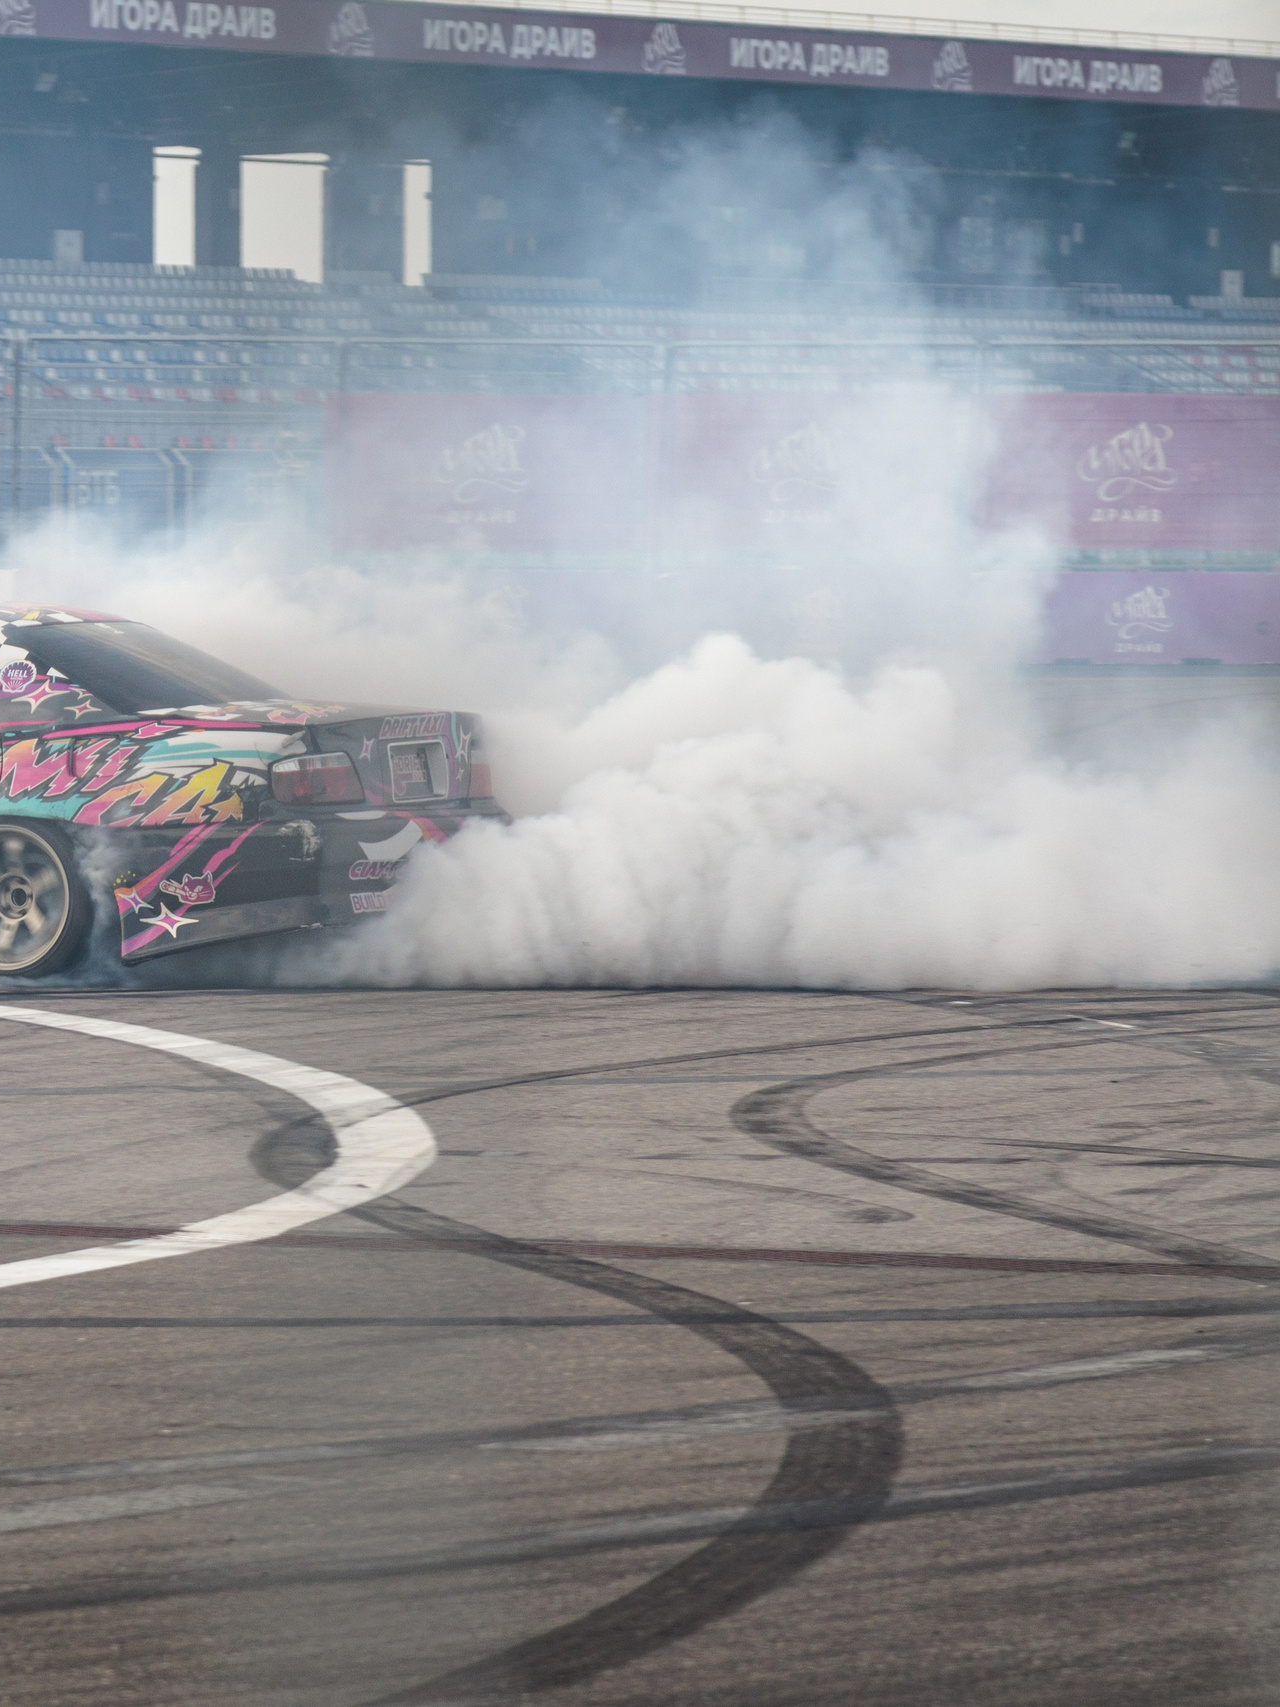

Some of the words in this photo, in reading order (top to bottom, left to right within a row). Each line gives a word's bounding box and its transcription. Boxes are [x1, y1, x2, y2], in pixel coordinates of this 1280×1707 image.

[424, 19, 506, 53] ИГОРА
[730, 37, 807, 72] ИГОРА
[1014, 55, 1084, 88] ИГОРА
[7, 669, 28, 678] HELL
